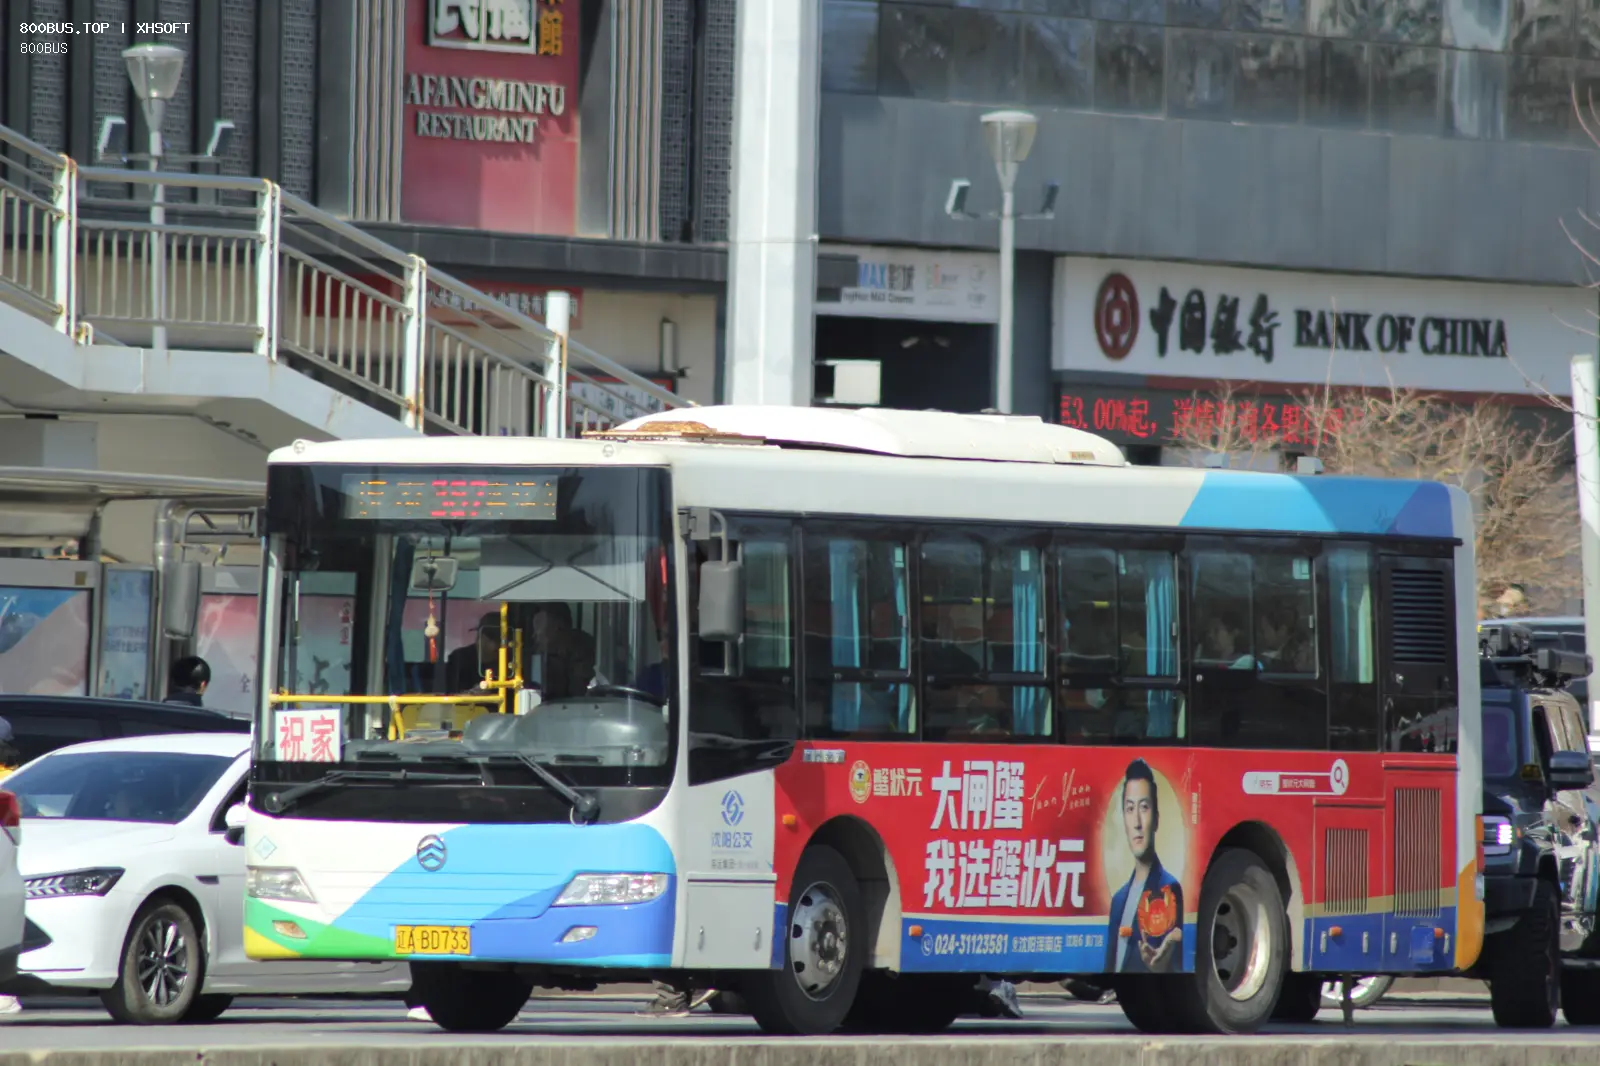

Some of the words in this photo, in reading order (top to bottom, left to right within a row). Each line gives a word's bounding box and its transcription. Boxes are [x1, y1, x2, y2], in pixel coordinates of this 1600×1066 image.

[406, 73, 566, 116] AFANGMINFU
[416, 110, 538, 143] RESTAURANT
[1294, 310, 1371, 350] BANK
[1377, 313, 1416, 352] OF
[1419, 317, 1508, 357] CHINA
[280, 715, 335, 762] 祝家
[930, 760, 1025, 830] 大闸蟹
[711, 831, 753, 849] 沈阳公交
[923, 839, 1086, 908] 我选蟹状元
[934, 934, 1009, 955] 024-31123581
